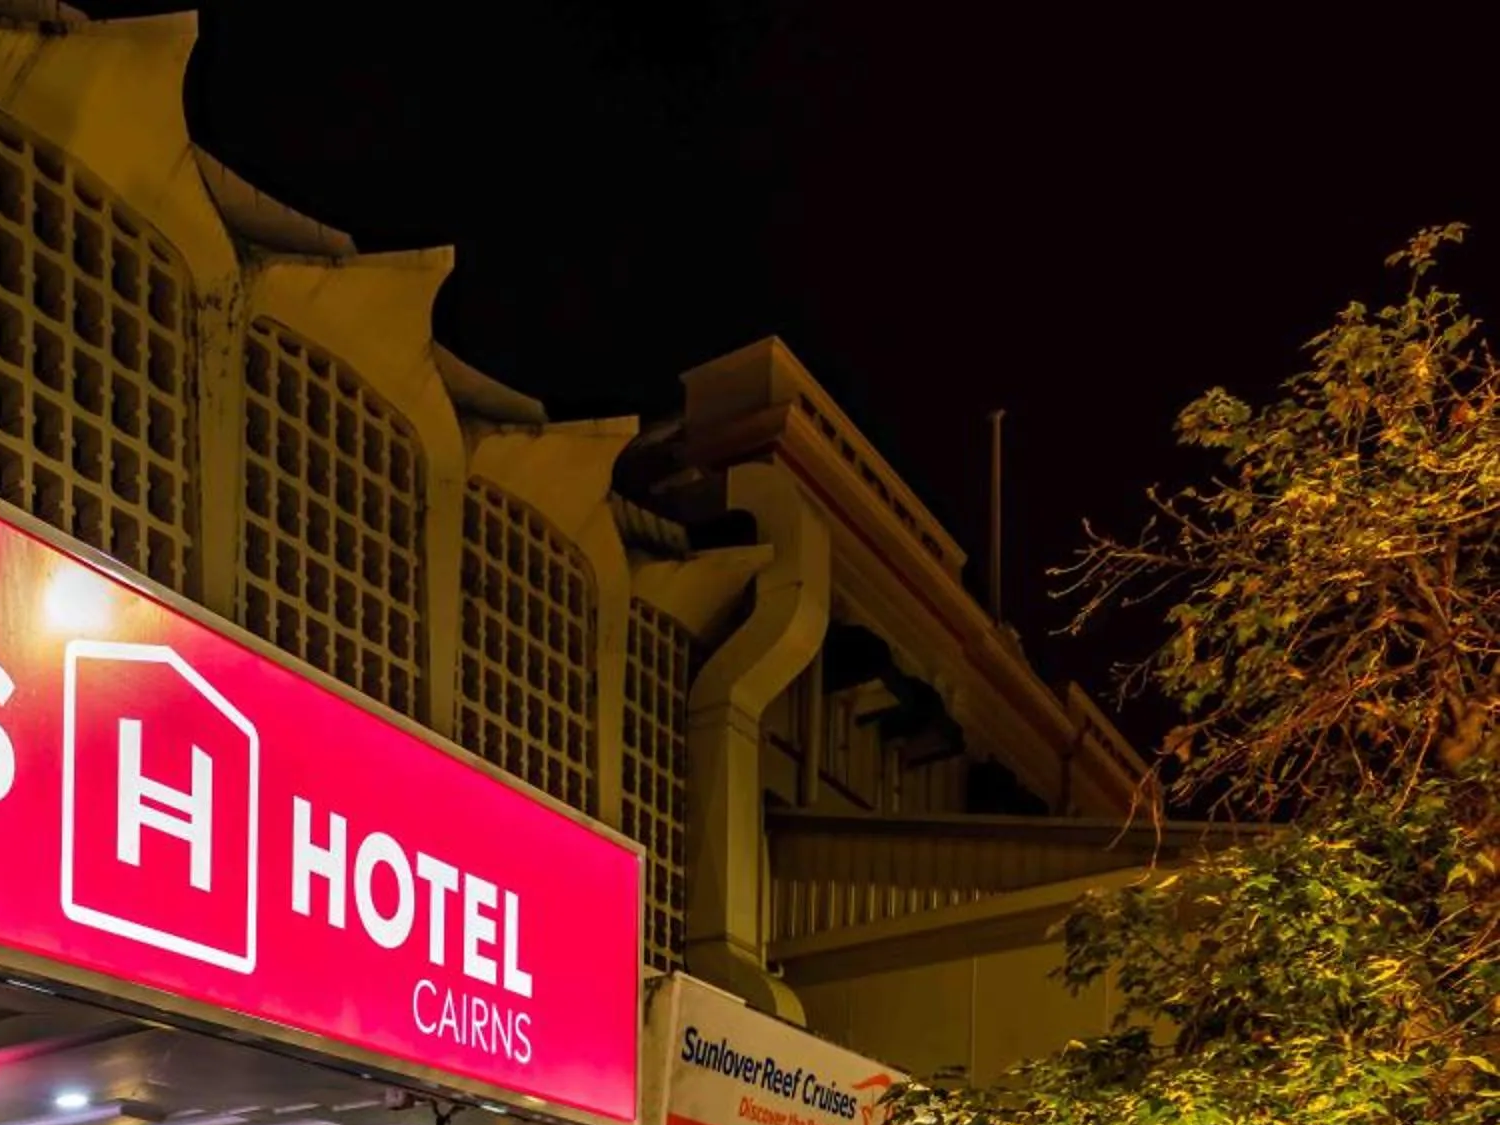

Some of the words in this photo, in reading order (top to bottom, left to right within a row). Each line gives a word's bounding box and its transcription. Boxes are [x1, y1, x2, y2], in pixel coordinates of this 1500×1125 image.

[116, 717, 213, 893] H
[290, 795, 533, 999] HOTEL
[412, 977, 532, 1066] CAIRNS
[681, 1026, 763, 1085] Sunlover
[762, 1058, 802, 1099] Reef
[802, 1074, 856, 1120] Cruises
